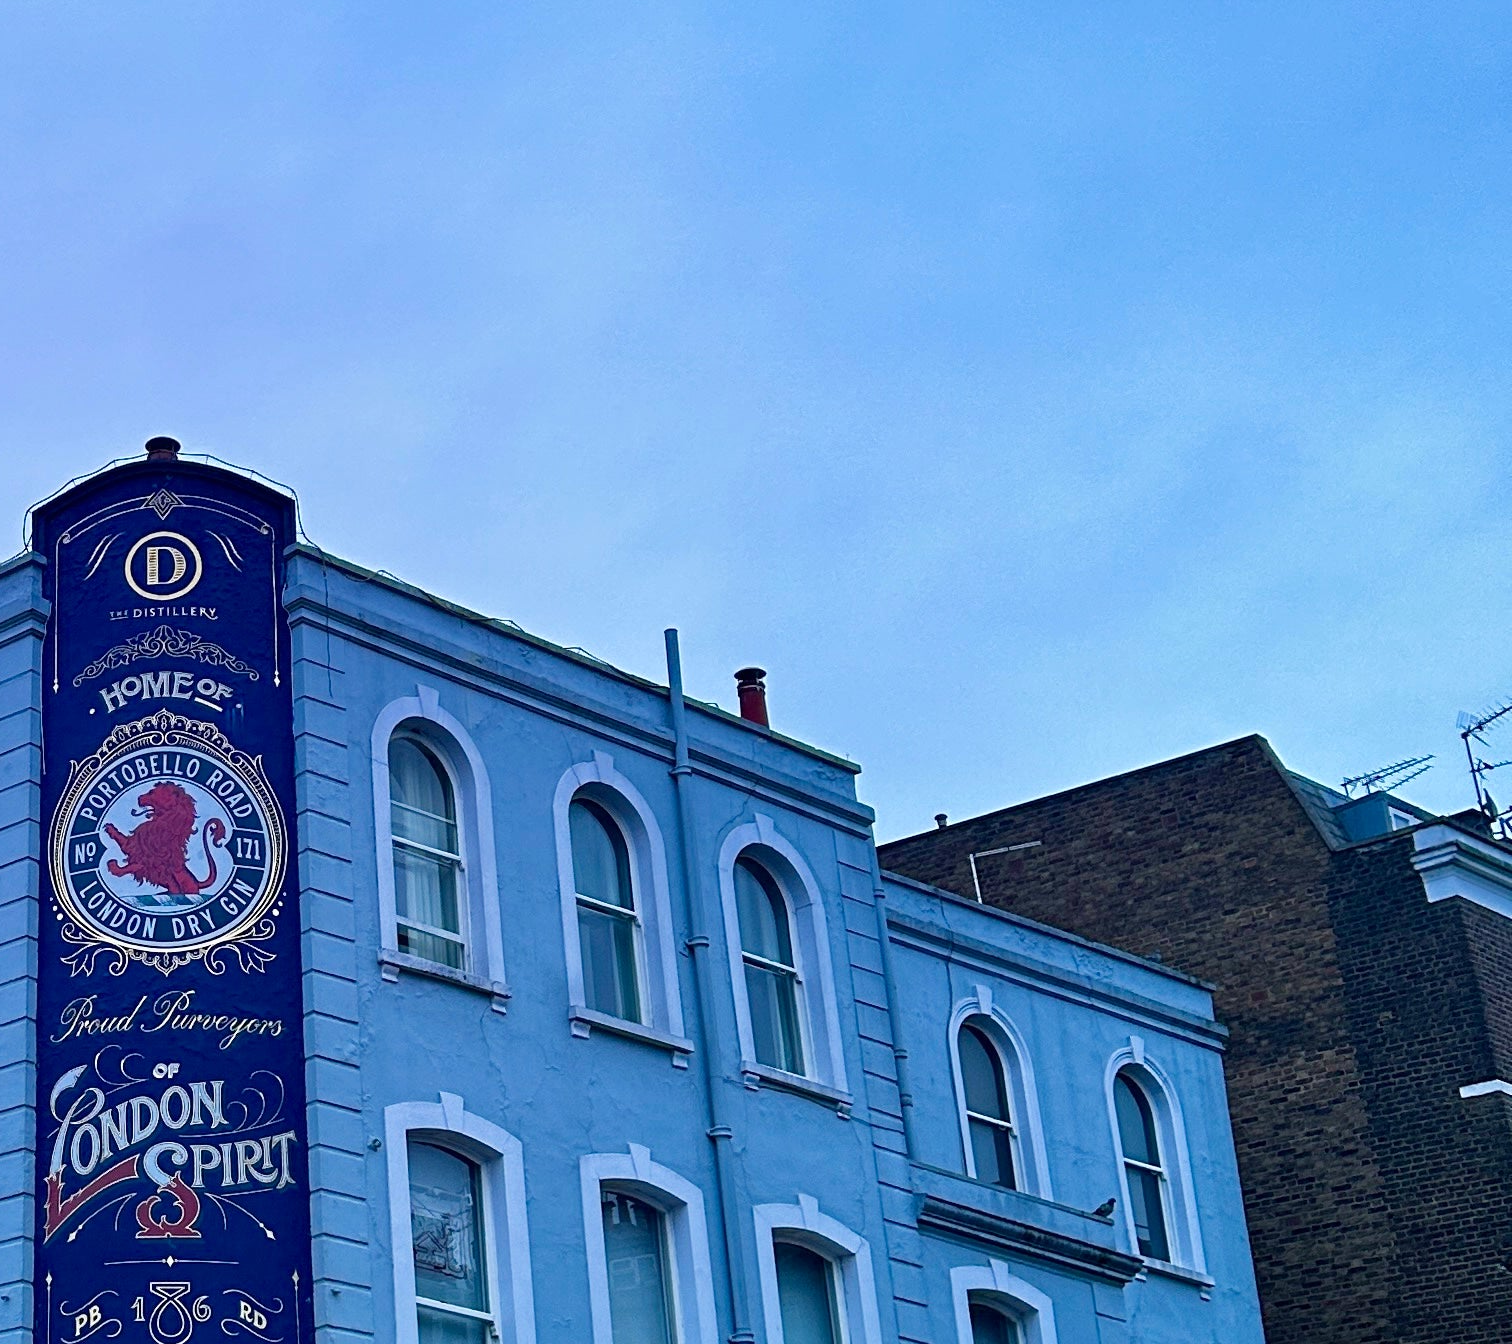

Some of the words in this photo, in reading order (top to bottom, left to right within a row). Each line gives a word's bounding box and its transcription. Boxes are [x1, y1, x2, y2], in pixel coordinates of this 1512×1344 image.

[146, 545, 186, 585] D
[109, 609, 128, 619] THE
[133, 607, 218, 620] DISTILLERY
[99, 671, 195, 713] HOME
[196, 678, 234, 702] OF
[80, 754, 200, 822] PORTOBELLO
[205, 769, 253, 818] ROAD
[236, 837, 261, 861] 171
[79, 880, 157, 939] LONDON
[172, 908, 216, 939] DRY
[220, 877, 255, 916] GIN
[50, 994, 147, 1042] Proud
[140, 990, 285, 1049] Purveyors
[152, 1062, 180, 1079] OF
[43, 1064, 229, 1244] LONDON
[135, 1130, 298, 1238] SPIRIT
[74, 1304, 102, 1337] PB
[239, 1299, 268, 1330] RD
